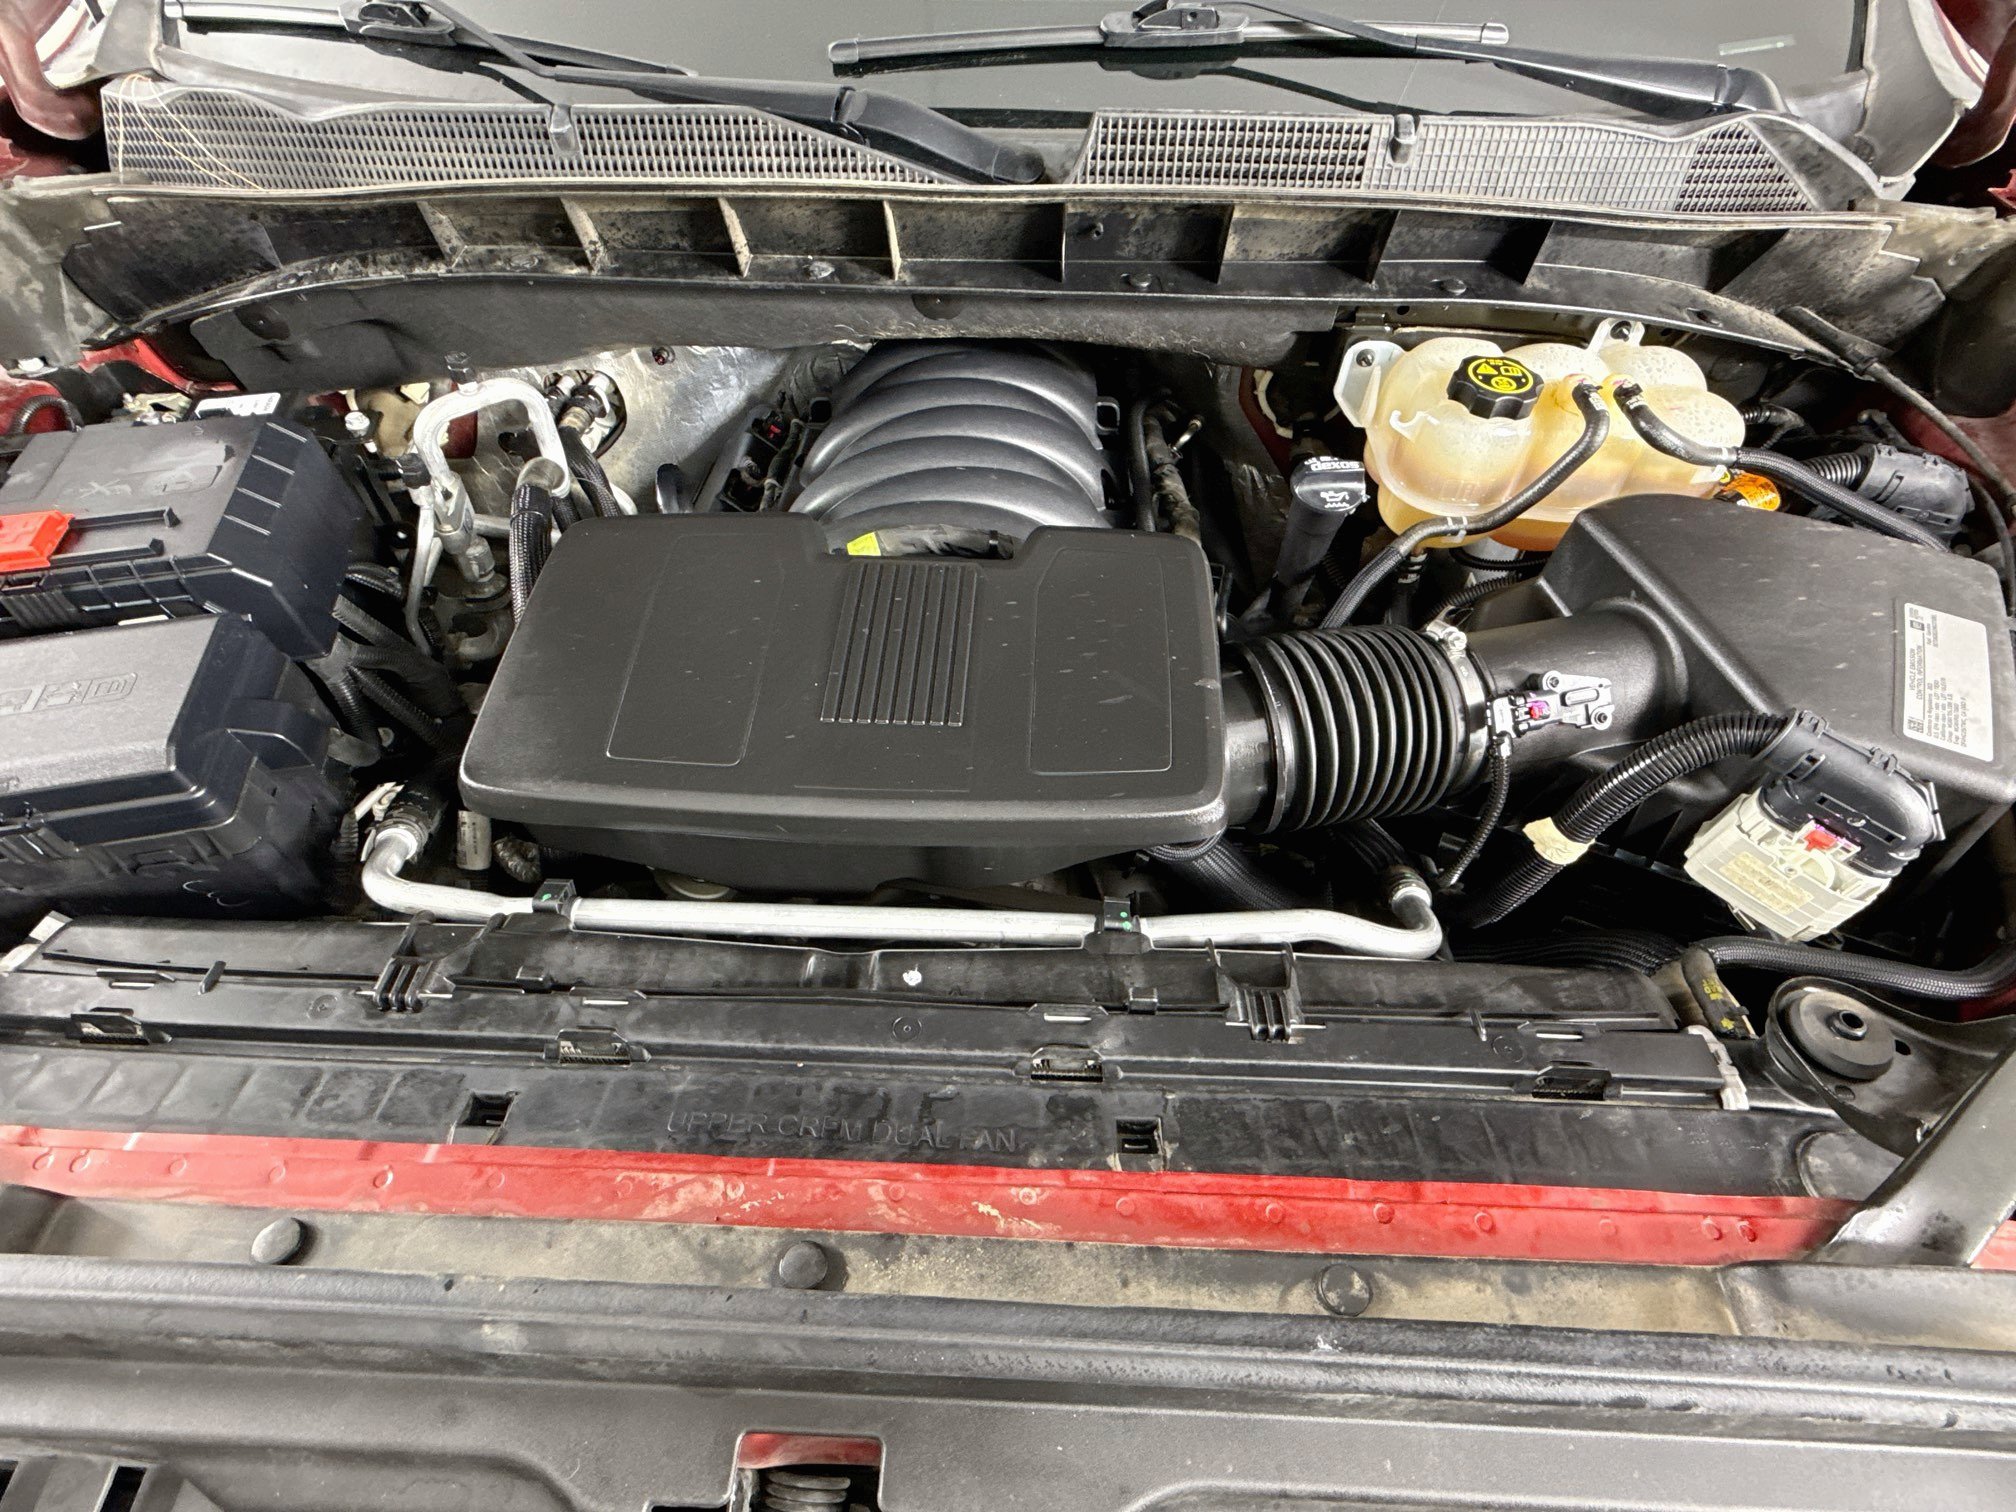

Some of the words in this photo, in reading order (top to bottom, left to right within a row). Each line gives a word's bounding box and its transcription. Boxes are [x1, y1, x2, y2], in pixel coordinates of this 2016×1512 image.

[1311, 461, 1360, 471] dexos
[667, 1111, 767, 1134] UPPER
[872, 1119, 950, 1149] DUAL
